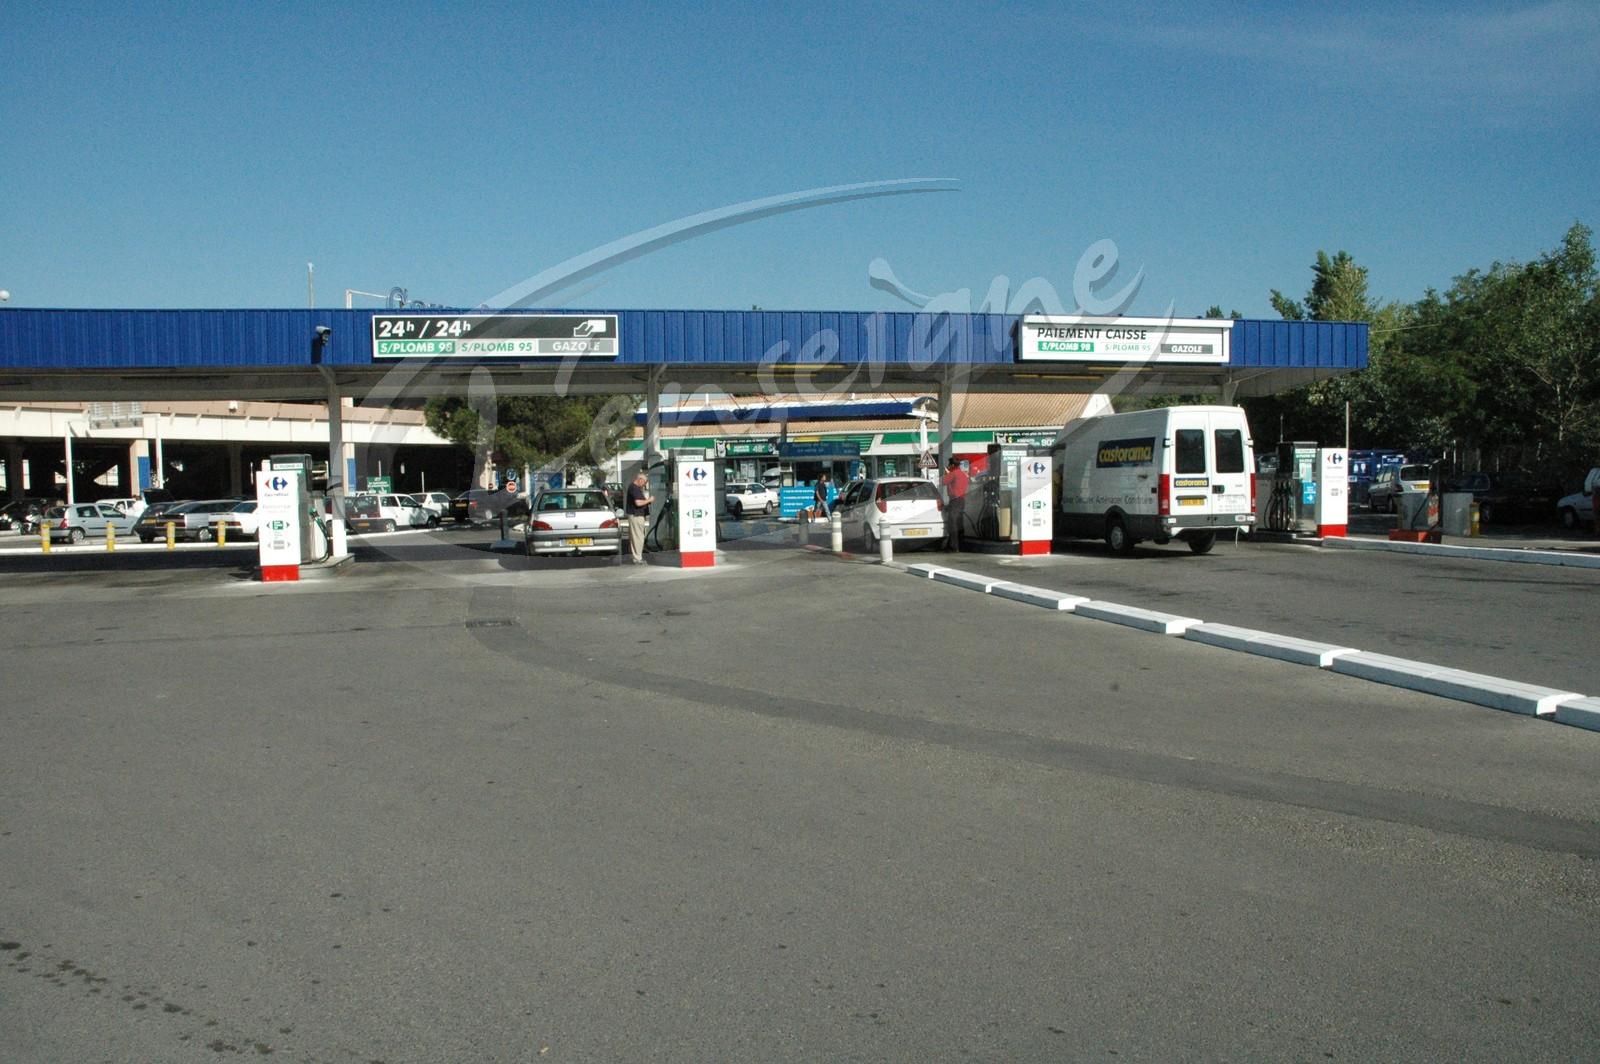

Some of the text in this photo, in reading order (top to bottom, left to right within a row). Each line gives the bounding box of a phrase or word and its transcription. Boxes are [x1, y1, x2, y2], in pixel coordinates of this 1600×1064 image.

[378, 320, 415, 338] 24h
[435, 319, 472, 338] 24h
[1036, 327, 1148, 341] PAIEMENT CAISSE
[380, 341, 601, 353] S/PLOMB 98 S/PLOMB 95 GAZOLE
[1041, 342, 1079, 351] S/PLOMB
[1080, 342, 1091, 352] 98
[1171, 345, 1203, 353] GAZOLE
[1099, 445, 1152, 464] castorama
[1175, 479, 1208, 487] castorama
